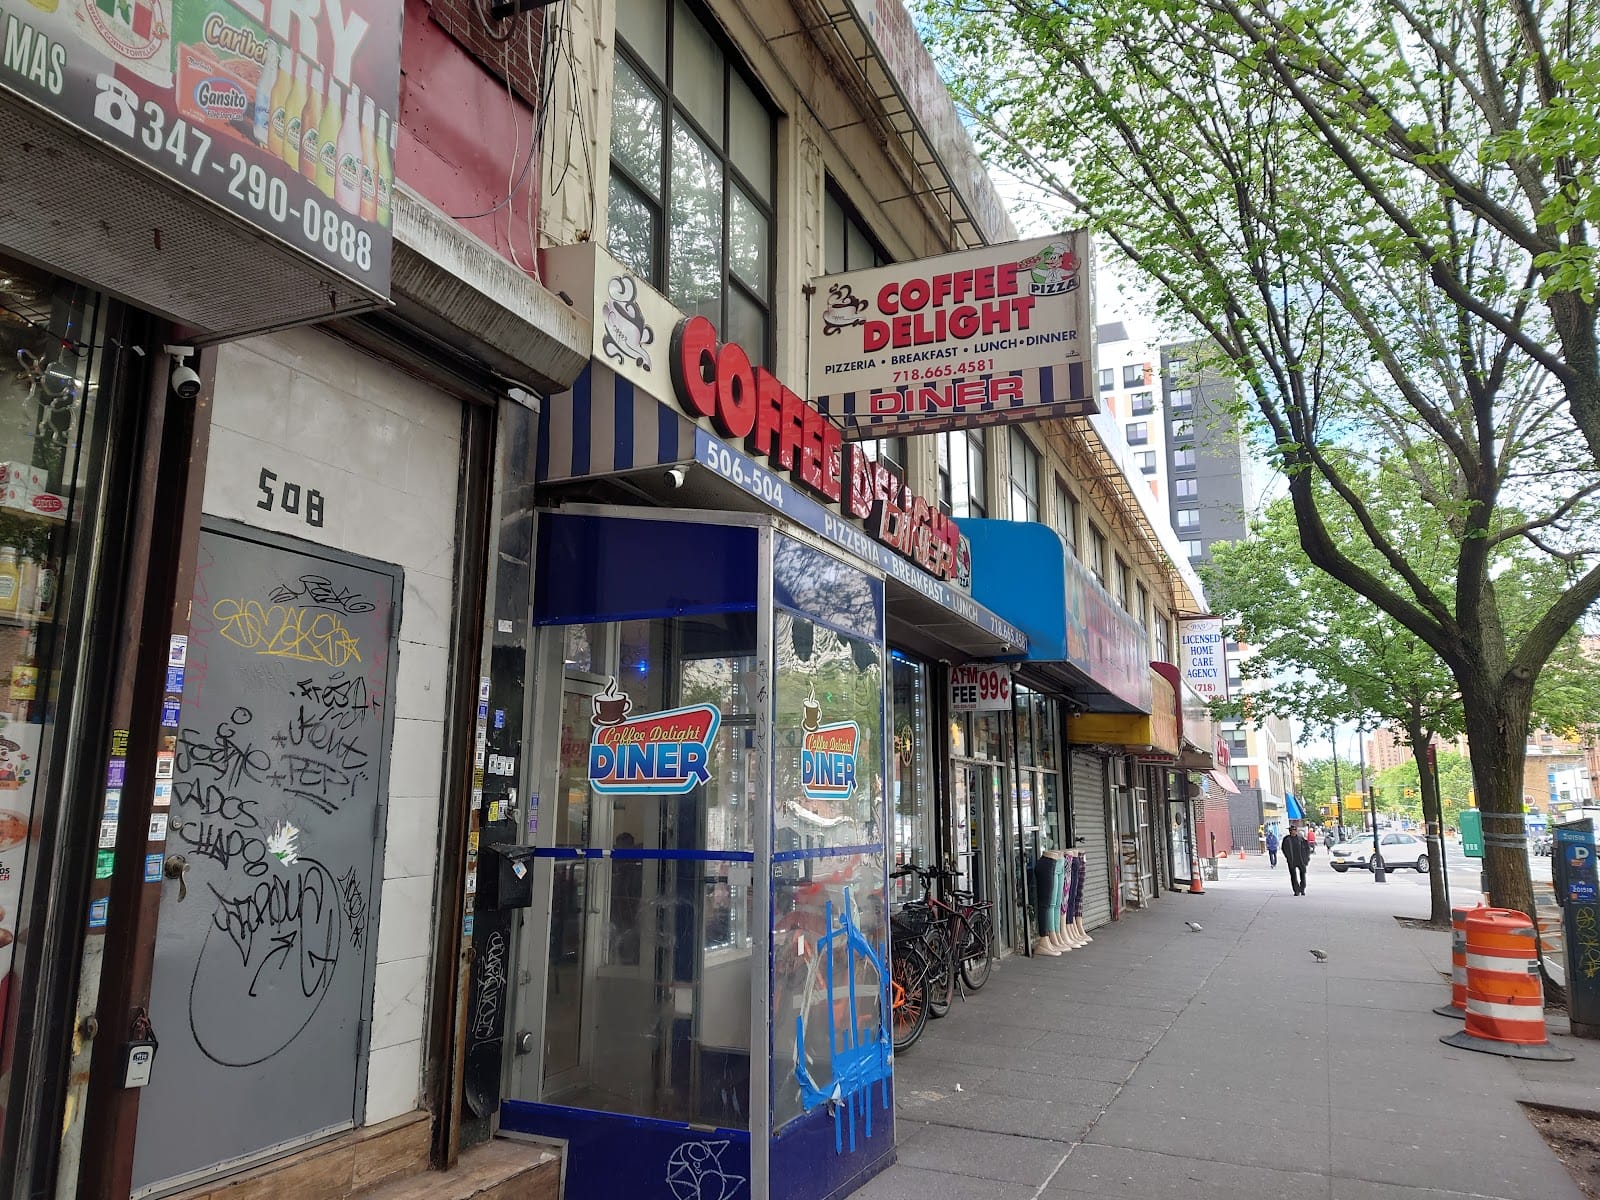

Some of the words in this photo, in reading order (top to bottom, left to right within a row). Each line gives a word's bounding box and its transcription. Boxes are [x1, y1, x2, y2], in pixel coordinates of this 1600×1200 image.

[4, 16, 67, 96] MAS
[232, 0, 369, 90] RY
[198, 83, 246, 108] Gansito
[141, 100, 372, 272] 347-290-0888
[878, 262, 1019, 315] COFFEE
[1031, 278, 1078, 294] PIZZA
[864, 296, 1035, 353] DELIGHT
[825, 359, 876, 374] PIZZERIA
[891, 347, 958, 365] BREAKFAST
[974, 338, 1017, 353] LUNCH
[1026, 330, 1077, 346] DINNER
[893, 359, 995, 383] 718.665.4581
[670, 315, 842, 503] COFFEE
[870, 376, 1024, 415] DINER
[706, 439, 784, 507] 506-504
[256, 467, 325, 528] 508
[877, 500, 954, 582] DINER
[824, 514, 880, 564] PIZZERIA
[891, 555, 944, 603] BREAKFAST
[952, 596, 978, 622] LUNCH
[1182, 634, 1221, 645] LICENSED
[1190, 646, 1214, 655] HOME
[951, 667, 978, 684] ATM
[1187, 668, 1218, 678] AGENCY
[1192, 657, 1214, 666] CARE
[952, 686, 977, 703] FEE
[1194, 683, 1216, 692] (718)
[603, 725, 645, 747] Coffee
[649, 724, 702, 744] Delight
[807, 735, 828, 751] Coffee
[588, 743, 712, 785] DINER
[801, 750, 857, 792] DINER
[1575, 846, 1590, 859] P
